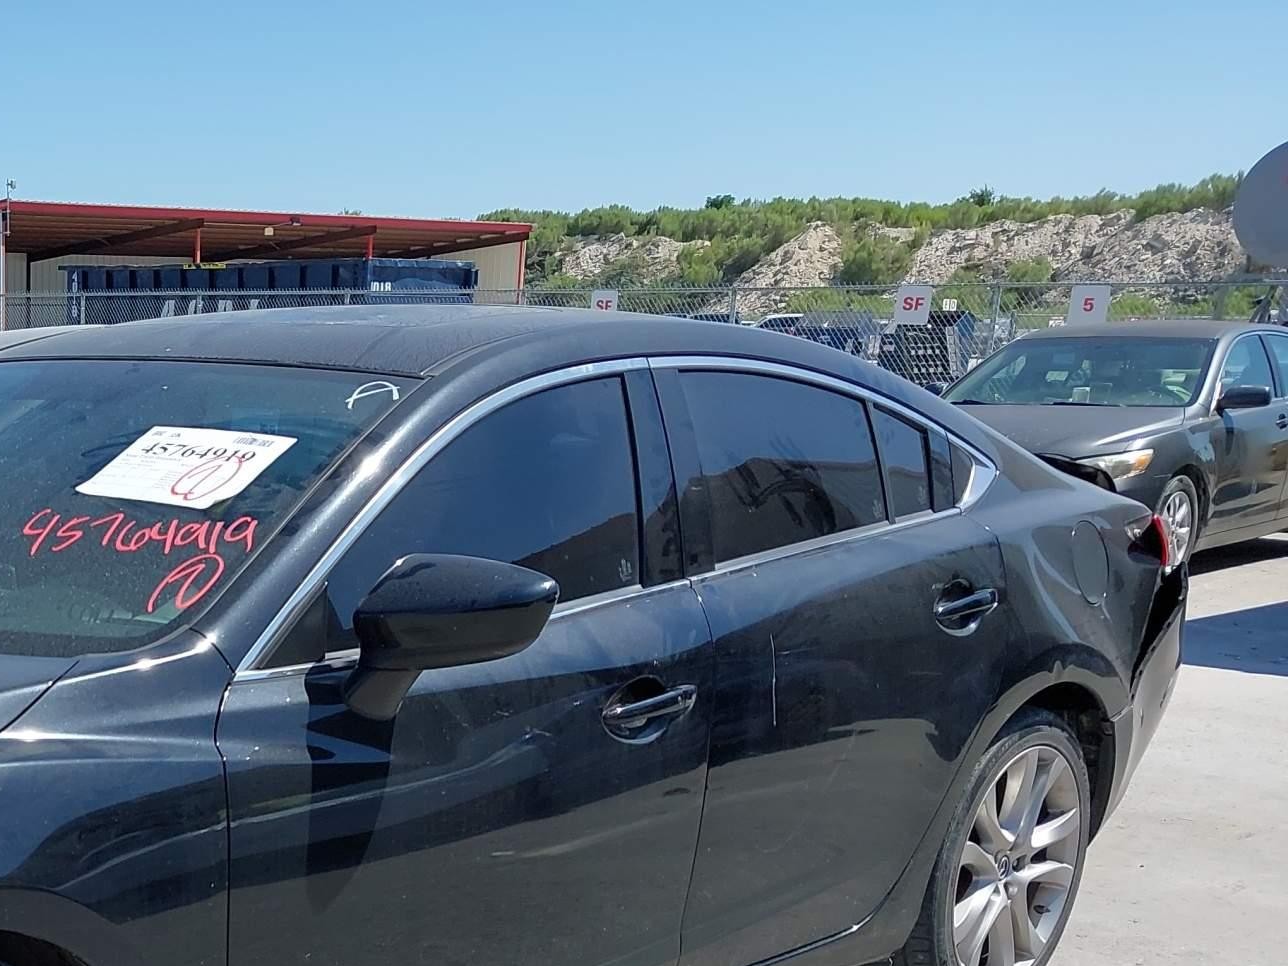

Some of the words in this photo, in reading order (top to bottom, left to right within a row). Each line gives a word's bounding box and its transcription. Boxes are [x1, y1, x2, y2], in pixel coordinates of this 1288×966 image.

[596, 299, 613, 310] SF
[902, 297, 925, 311] SF
[1083, 298, 1095, 312] 5
[140, 442, 256, 463] 45764919
[22, 508, 258, 556] 45764919
